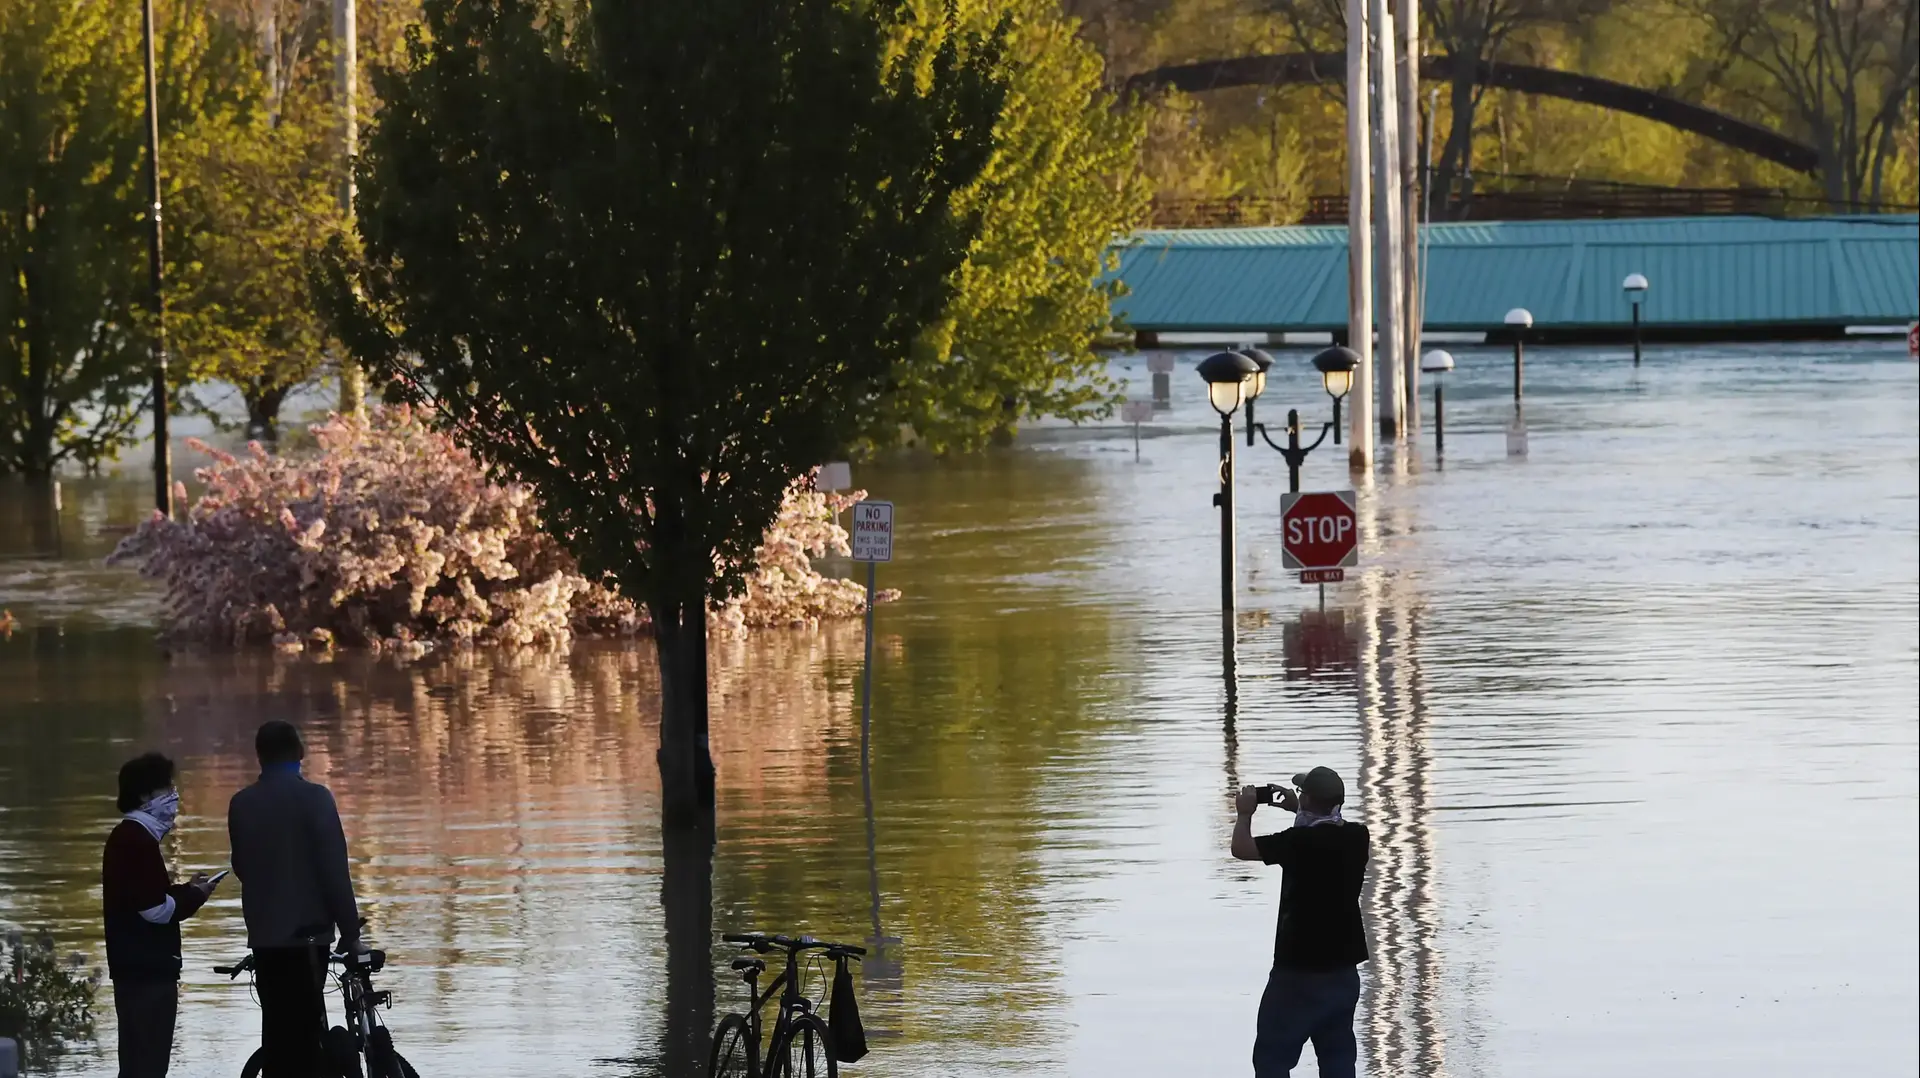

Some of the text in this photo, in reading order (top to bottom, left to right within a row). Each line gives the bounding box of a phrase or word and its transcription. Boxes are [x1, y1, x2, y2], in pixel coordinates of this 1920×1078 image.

[865, 508, 880, 520] NO
[856, 521, 889, 532] PARKING
[1288, 515, 1352, 544] STOP
[1303, 571, 1341, 581] ALL WAY
